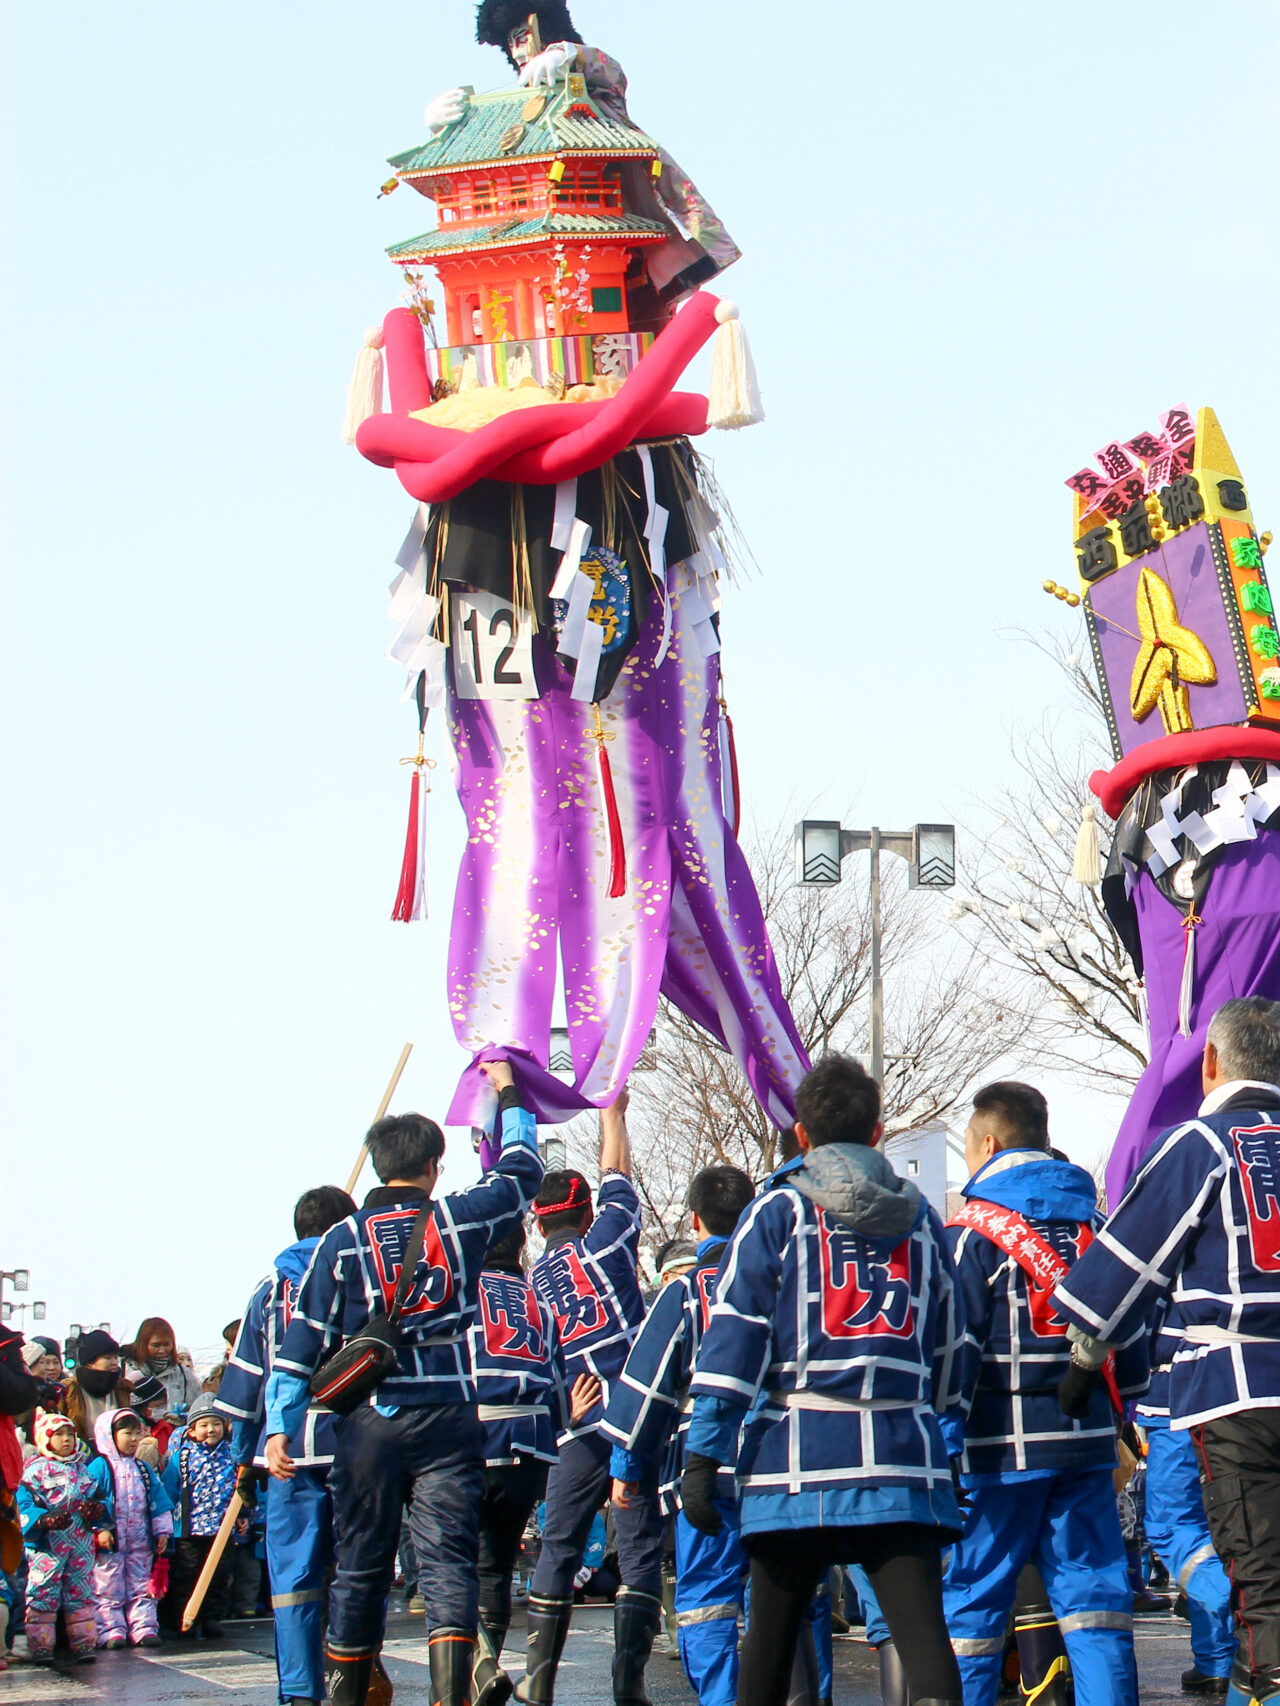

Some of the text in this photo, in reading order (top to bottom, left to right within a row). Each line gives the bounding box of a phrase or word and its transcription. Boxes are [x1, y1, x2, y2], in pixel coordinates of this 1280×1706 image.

[464, 608, 523, 685] 12
[481, 1273, 545, 1357] 電力
[530, 1250, 603, 1337] 電力
